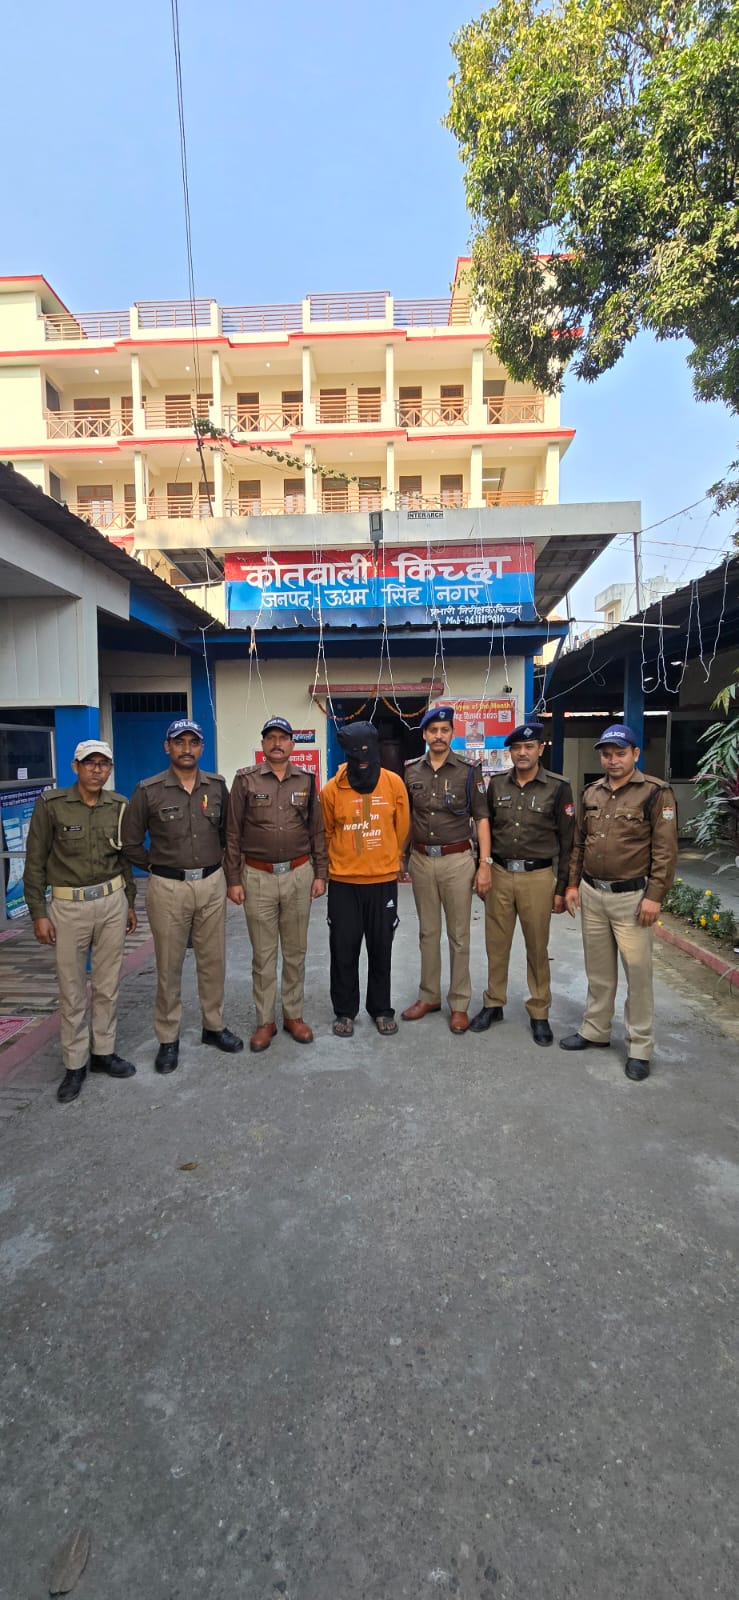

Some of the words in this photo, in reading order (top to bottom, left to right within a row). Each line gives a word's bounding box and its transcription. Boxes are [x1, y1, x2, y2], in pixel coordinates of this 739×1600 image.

[241, 553, 372, 589] कोतवाली
[391, 552, 512, 584] किच्छा
[261, 591, 312, 610] जनपद
[324, 589, 369, 606] ऊधम
[381, 584, 422, 605] सिंह
[435, 585, 483, 603] नगर
[430, 605, 455, 617] प्रभारी
[175, 721, 201, 730] POLICE
[601, 731, 626, 740] POLICE
